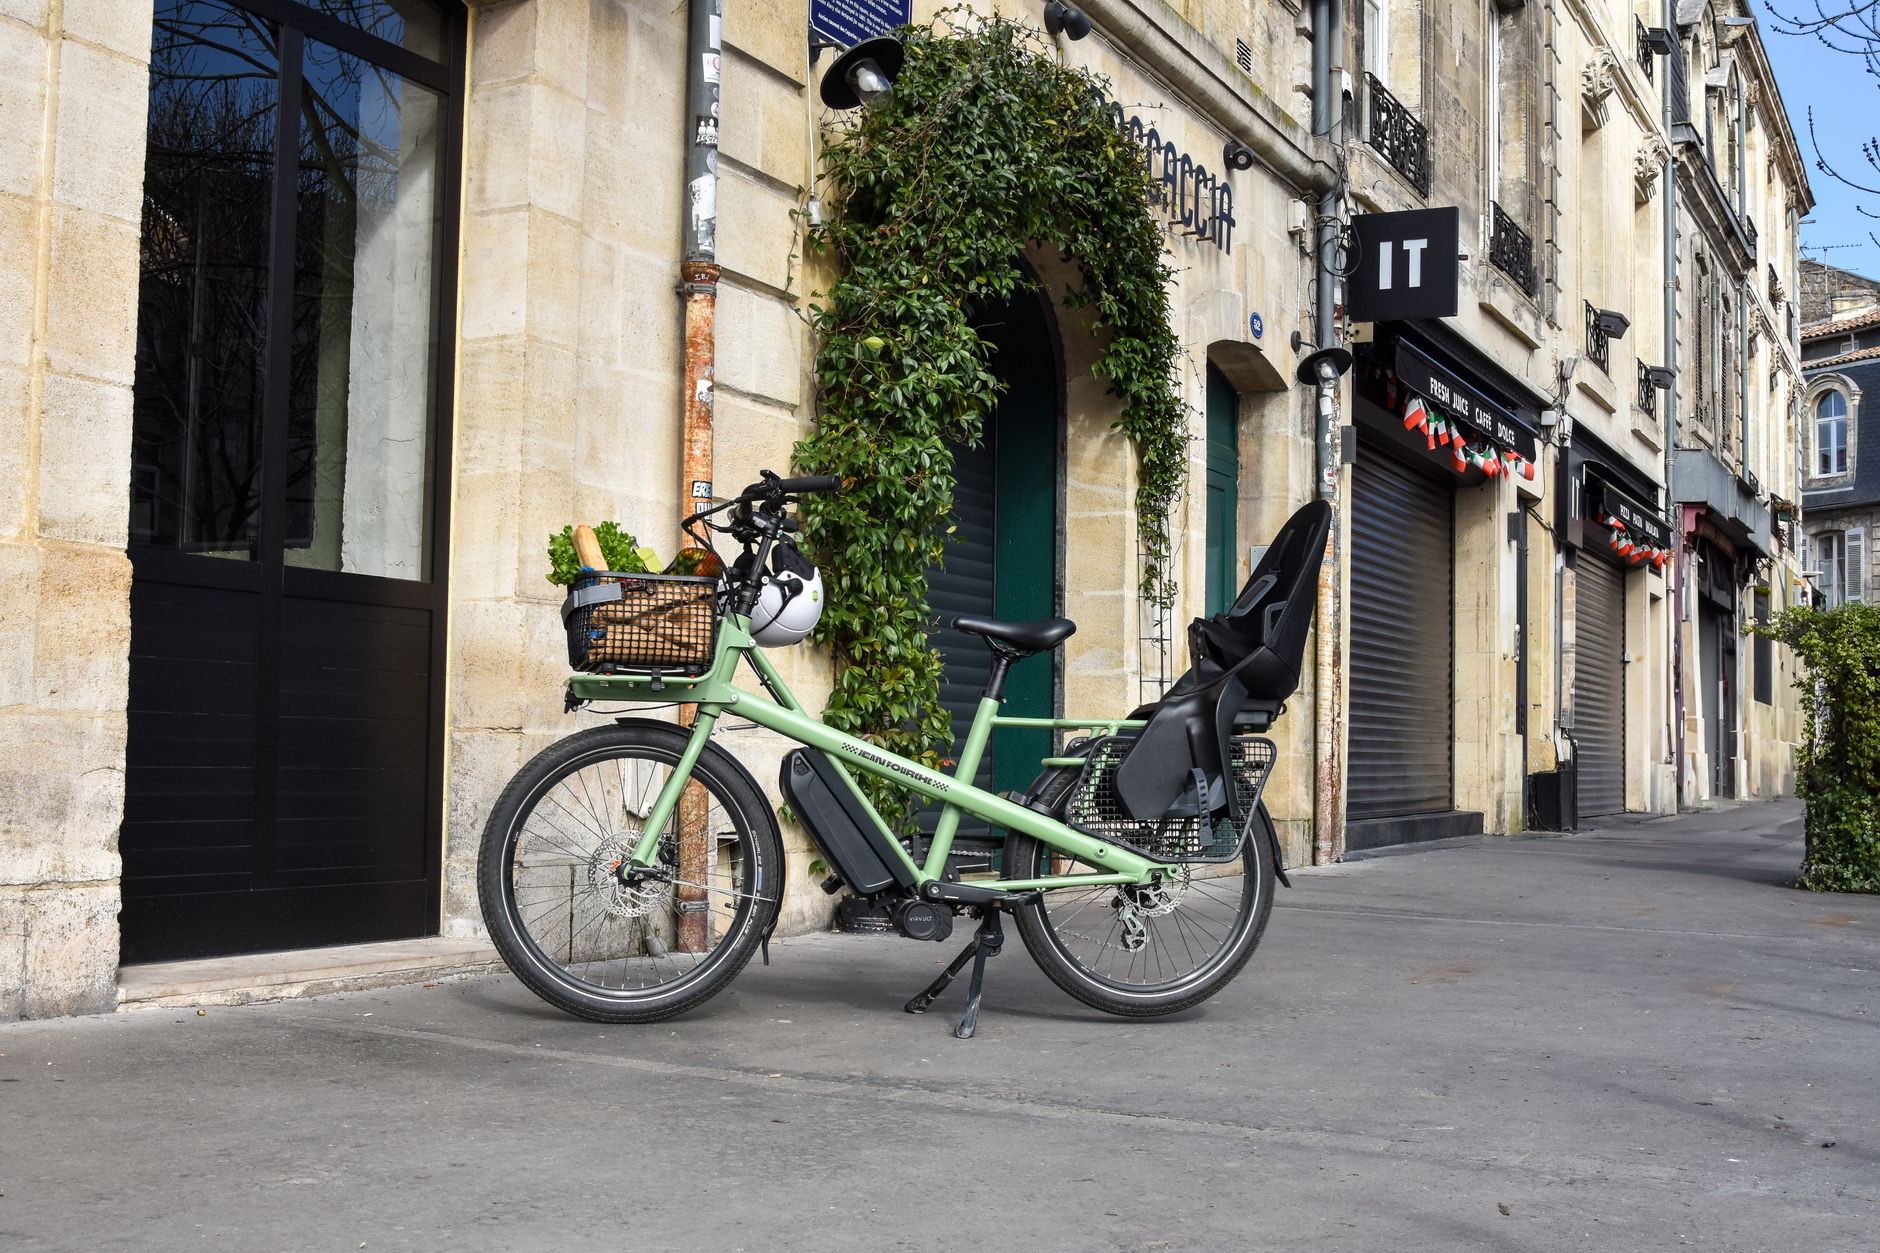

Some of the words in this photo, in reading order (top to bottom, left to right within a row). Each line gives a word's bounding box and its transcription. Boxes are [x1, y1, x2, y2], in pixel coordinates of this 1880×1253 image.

[1379, 238, 1428, 290] IT
[1430, 376, 1450, 405] FRESH
[1452, 392, 1468, 416] JUICE
[1498, 422, 1515, 446] DOLCE
[1572, 476, 1580, 520] IT
